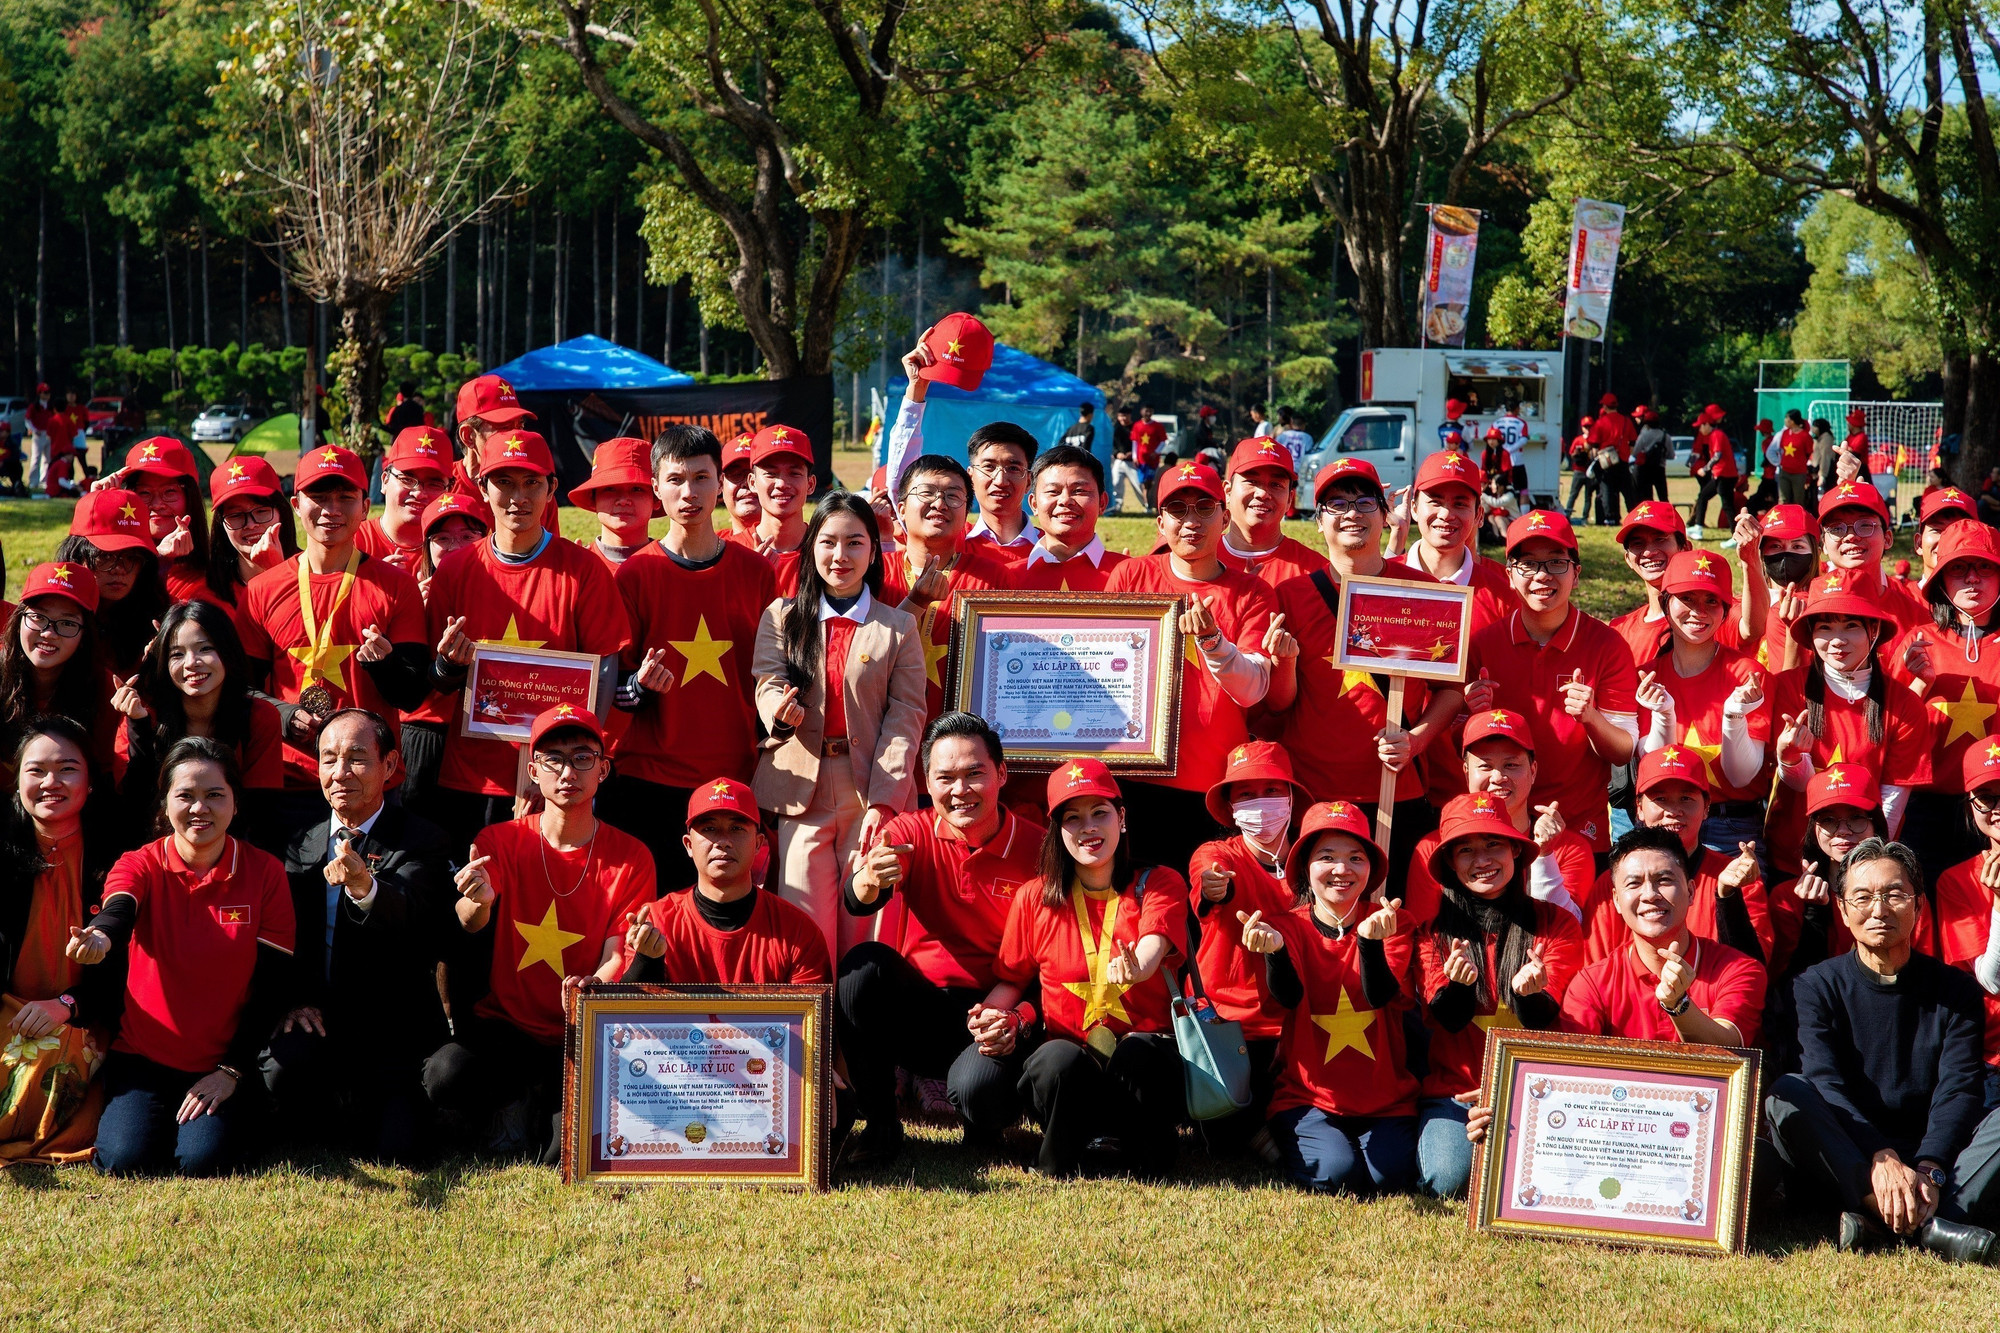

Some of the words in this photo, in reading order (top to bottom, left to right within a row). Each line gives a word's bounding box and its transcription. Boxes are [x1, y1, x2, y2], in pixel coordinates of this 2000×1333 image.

[638, 411, 768, 444] VIEAMESE
[1354, 614, 1382, 622] DOANH
[1384, 616, 1412, 626] NGHIỆP
[1414, 618, 1430, 627] VIỆT
[1436, 620, 1457, 629] NHẬT
[1032, 661, 1049, 671] XÁC
[1052, 661, 1068, 672] LẬP
[1070, 660, 1081, 670] KỶ
[1084, 663, 1100, 672] LỤC
[499, 679, 522, 688] ĐỘNG
[523, 681, 533, 689] KỸ
[535, 682, 559, 694] NĂNG,
[561, 686, 571, 694] KỸ
[573, 687, 584, 695] SƯ
[503, 691, 525, 700] THỰC
[526, 693, 540, 701] TẬP
[658, 1062, 677, 1073] XÁC
[680, 1061, 698, 1075] LẬP
[701, 1060, 714, 1073] KỶ
[717, 1063, 735, 1075] LỤC
[1577, 1116, 1597, 1128] XÁC
[1600, 1118, 1619, 1131] LẬP
[1621, 1119, 1635, 1131] KỶ
[1638, 1123, 1657, 1134] LỤC
